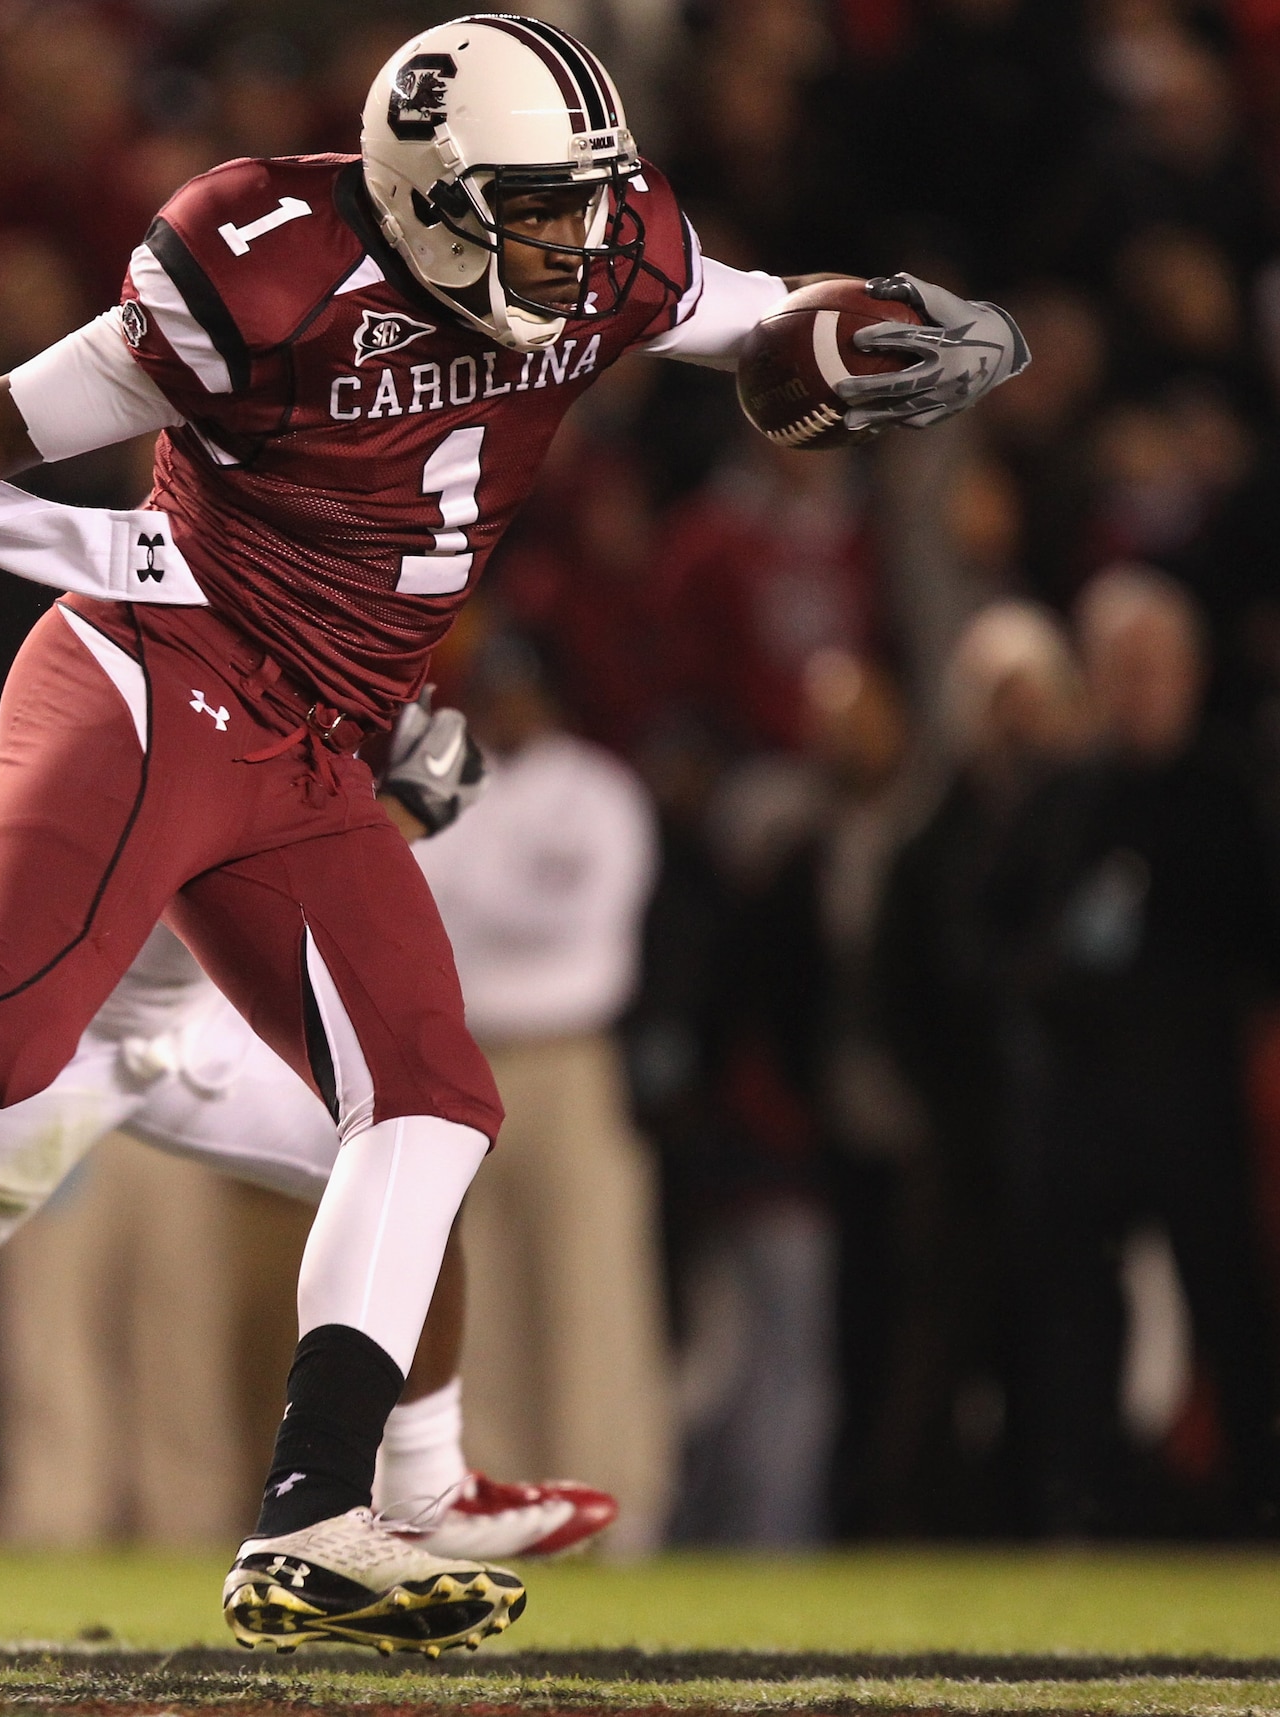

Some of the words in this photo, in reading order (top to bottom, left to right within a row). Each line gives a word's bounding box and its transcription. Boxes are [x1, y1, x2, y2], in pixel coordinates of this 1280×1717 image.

[217, 196, 312, 256] 1
[372, 321, 401, 347] SEC
[330, 334, 601, 420] CAROLINA
[395, 426, 485, 595] 1
